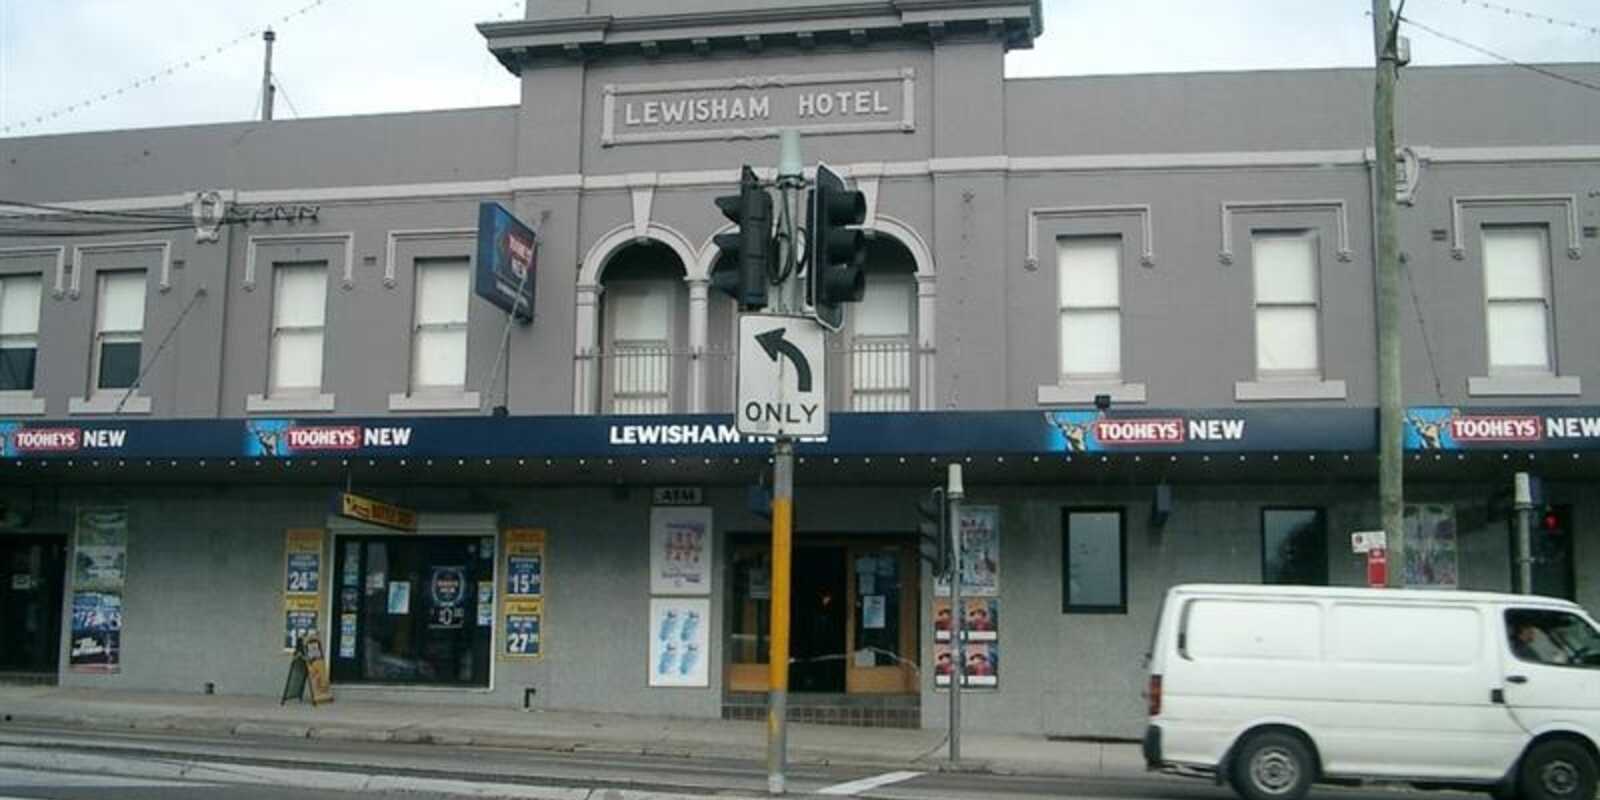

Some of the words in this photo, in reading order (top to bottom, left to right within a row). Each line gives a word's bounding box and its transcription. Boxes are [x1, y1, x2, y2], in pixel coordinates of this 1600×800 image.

[625, 95, 770, 125] LEWISHAM
[798, 90, 890, 116] HOTEL
[745, 402, 818, 423] ONLY
[288, 429, 355, 447] TOOHEYS
[364, 427, 411, 446] NEW
[609, 425, 740, 445] LEWISHAM
[1099, 422, 1178, 440] TOOHEYS
[1188, 420, 1245, 440] NEW
[1453, 420, 1537, 438] TOOHEYS
[1546, 418, 1600, 438] NEW
[17, 431, 76, 448] TOOHEYS
[83, 430, 127, 448] NEW
